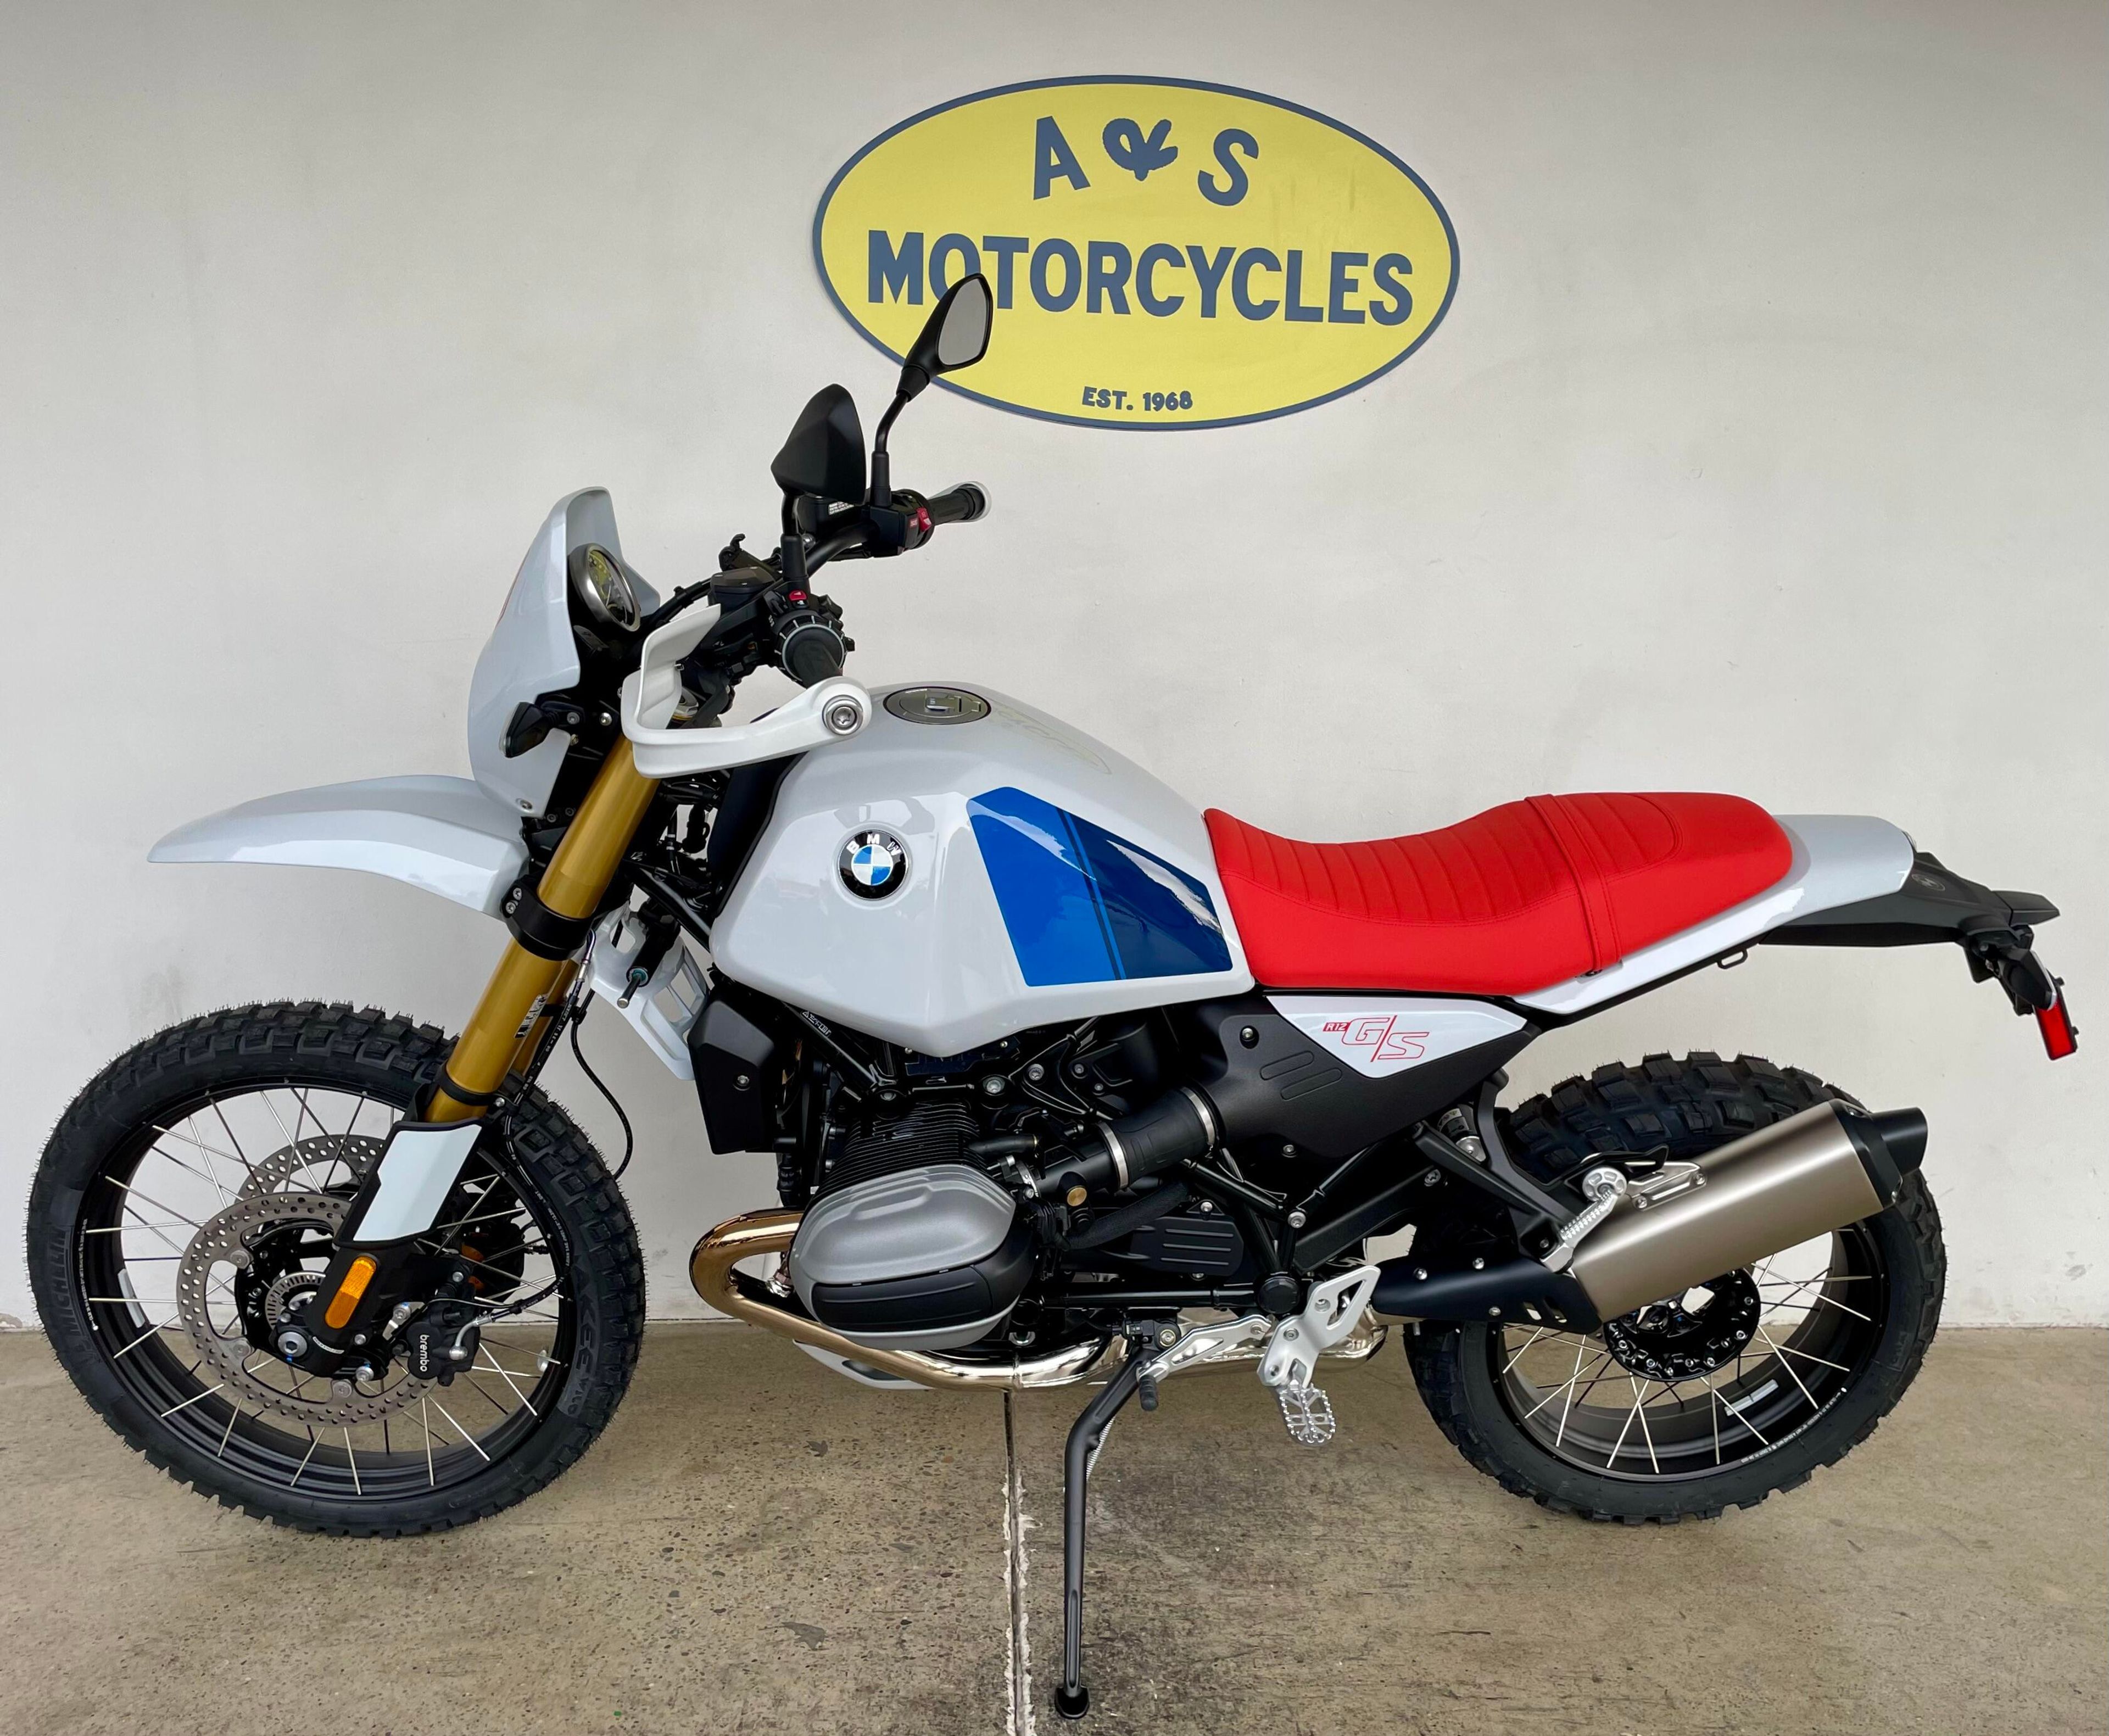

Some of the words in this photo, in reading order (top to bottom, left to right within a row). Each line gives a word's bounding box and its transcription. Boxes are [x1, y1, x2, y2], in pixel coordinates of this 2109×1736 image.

[1034, 116, 1090, 200] A
[1198, 129, 1259, 206] S
[868, 230, 1413, 326] MOTORCYCLES
[1082, 386, 1134, 410] EST.
[1142, 390, 1193, 411] 1968
[846, 834, 901, 855] BMW
[1325, 1023, 1348, 1031] R12
[420, 1334, 430, 1372] brembo
